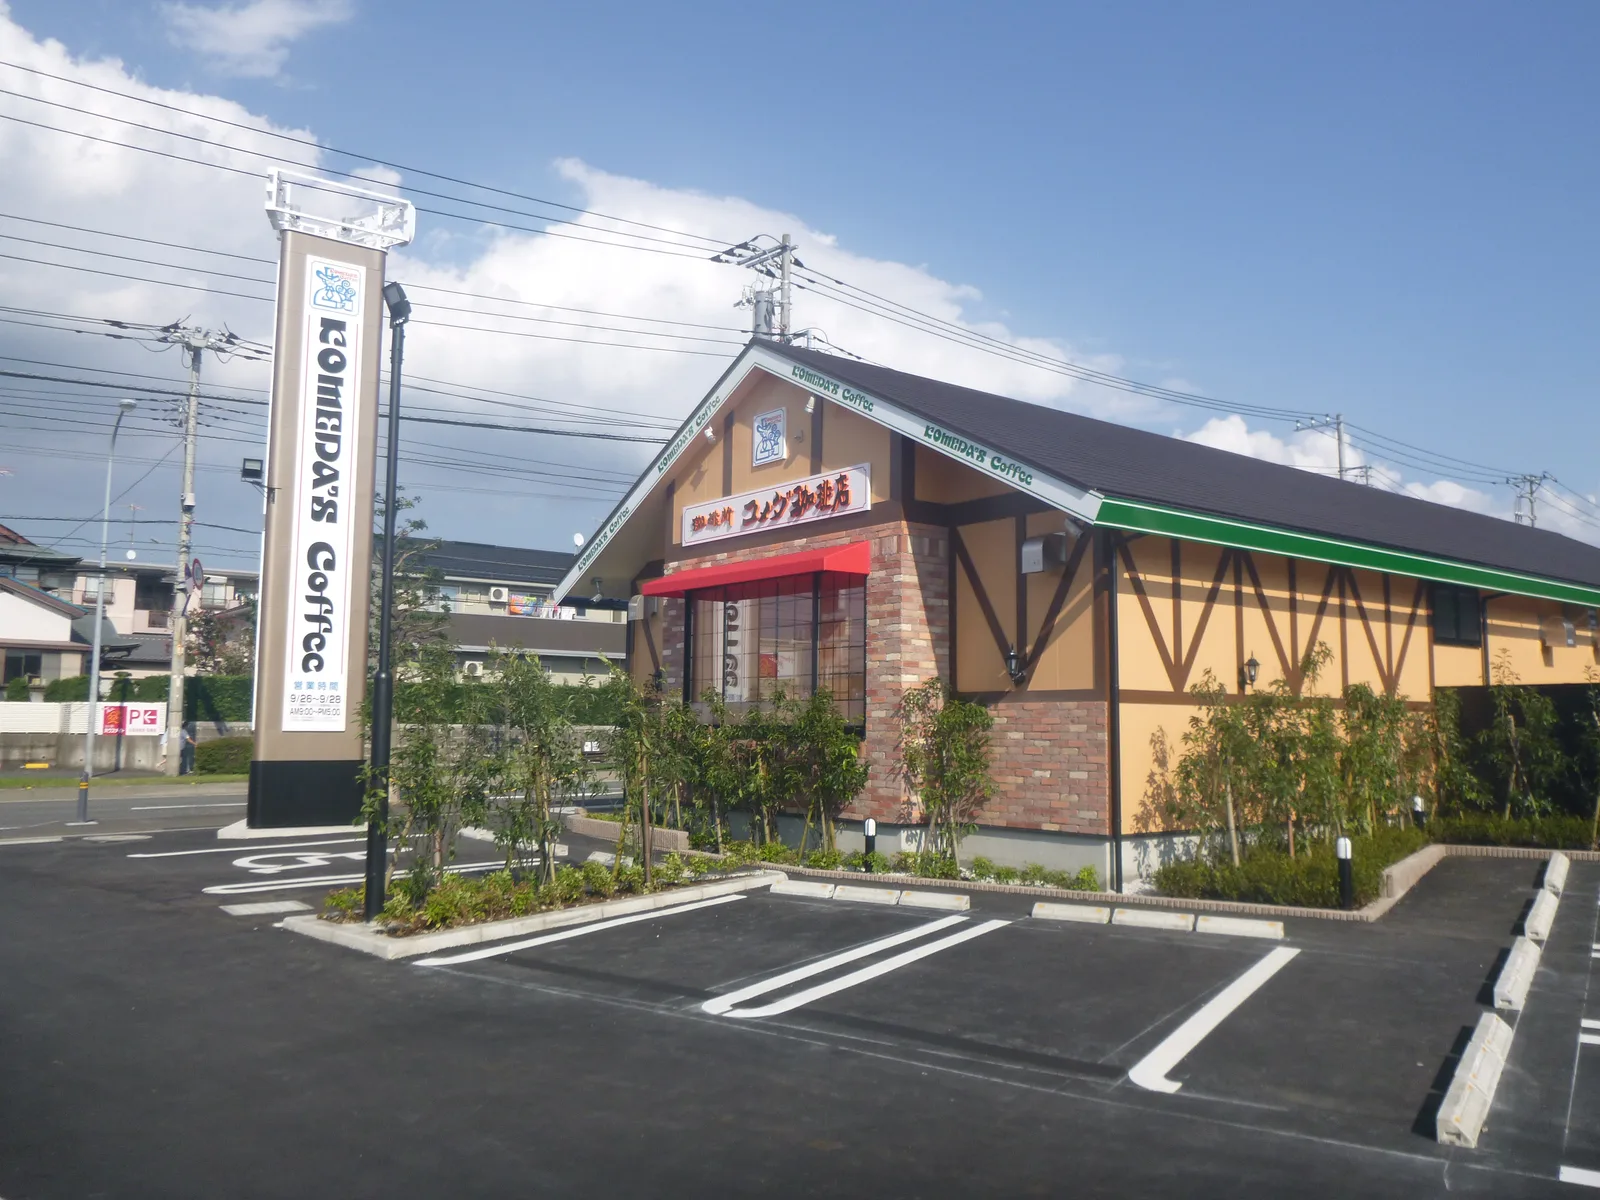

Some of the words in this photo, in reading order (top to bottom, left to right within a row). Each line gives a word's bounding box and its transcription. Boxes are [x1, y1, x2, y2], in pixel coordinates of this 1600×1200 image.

[791, 365, 840, 395] KOMEDA'S
[842, 388, 874, 413] Coffee
[311, 317, 347, 523] KOMEDA'S
[924, 425, 987, 463] KOMEDA'S
[990, 456, 1033, 486] Coffee
[301, 541, 336, 674] Coffee
[129, 709, 140, 725] P
